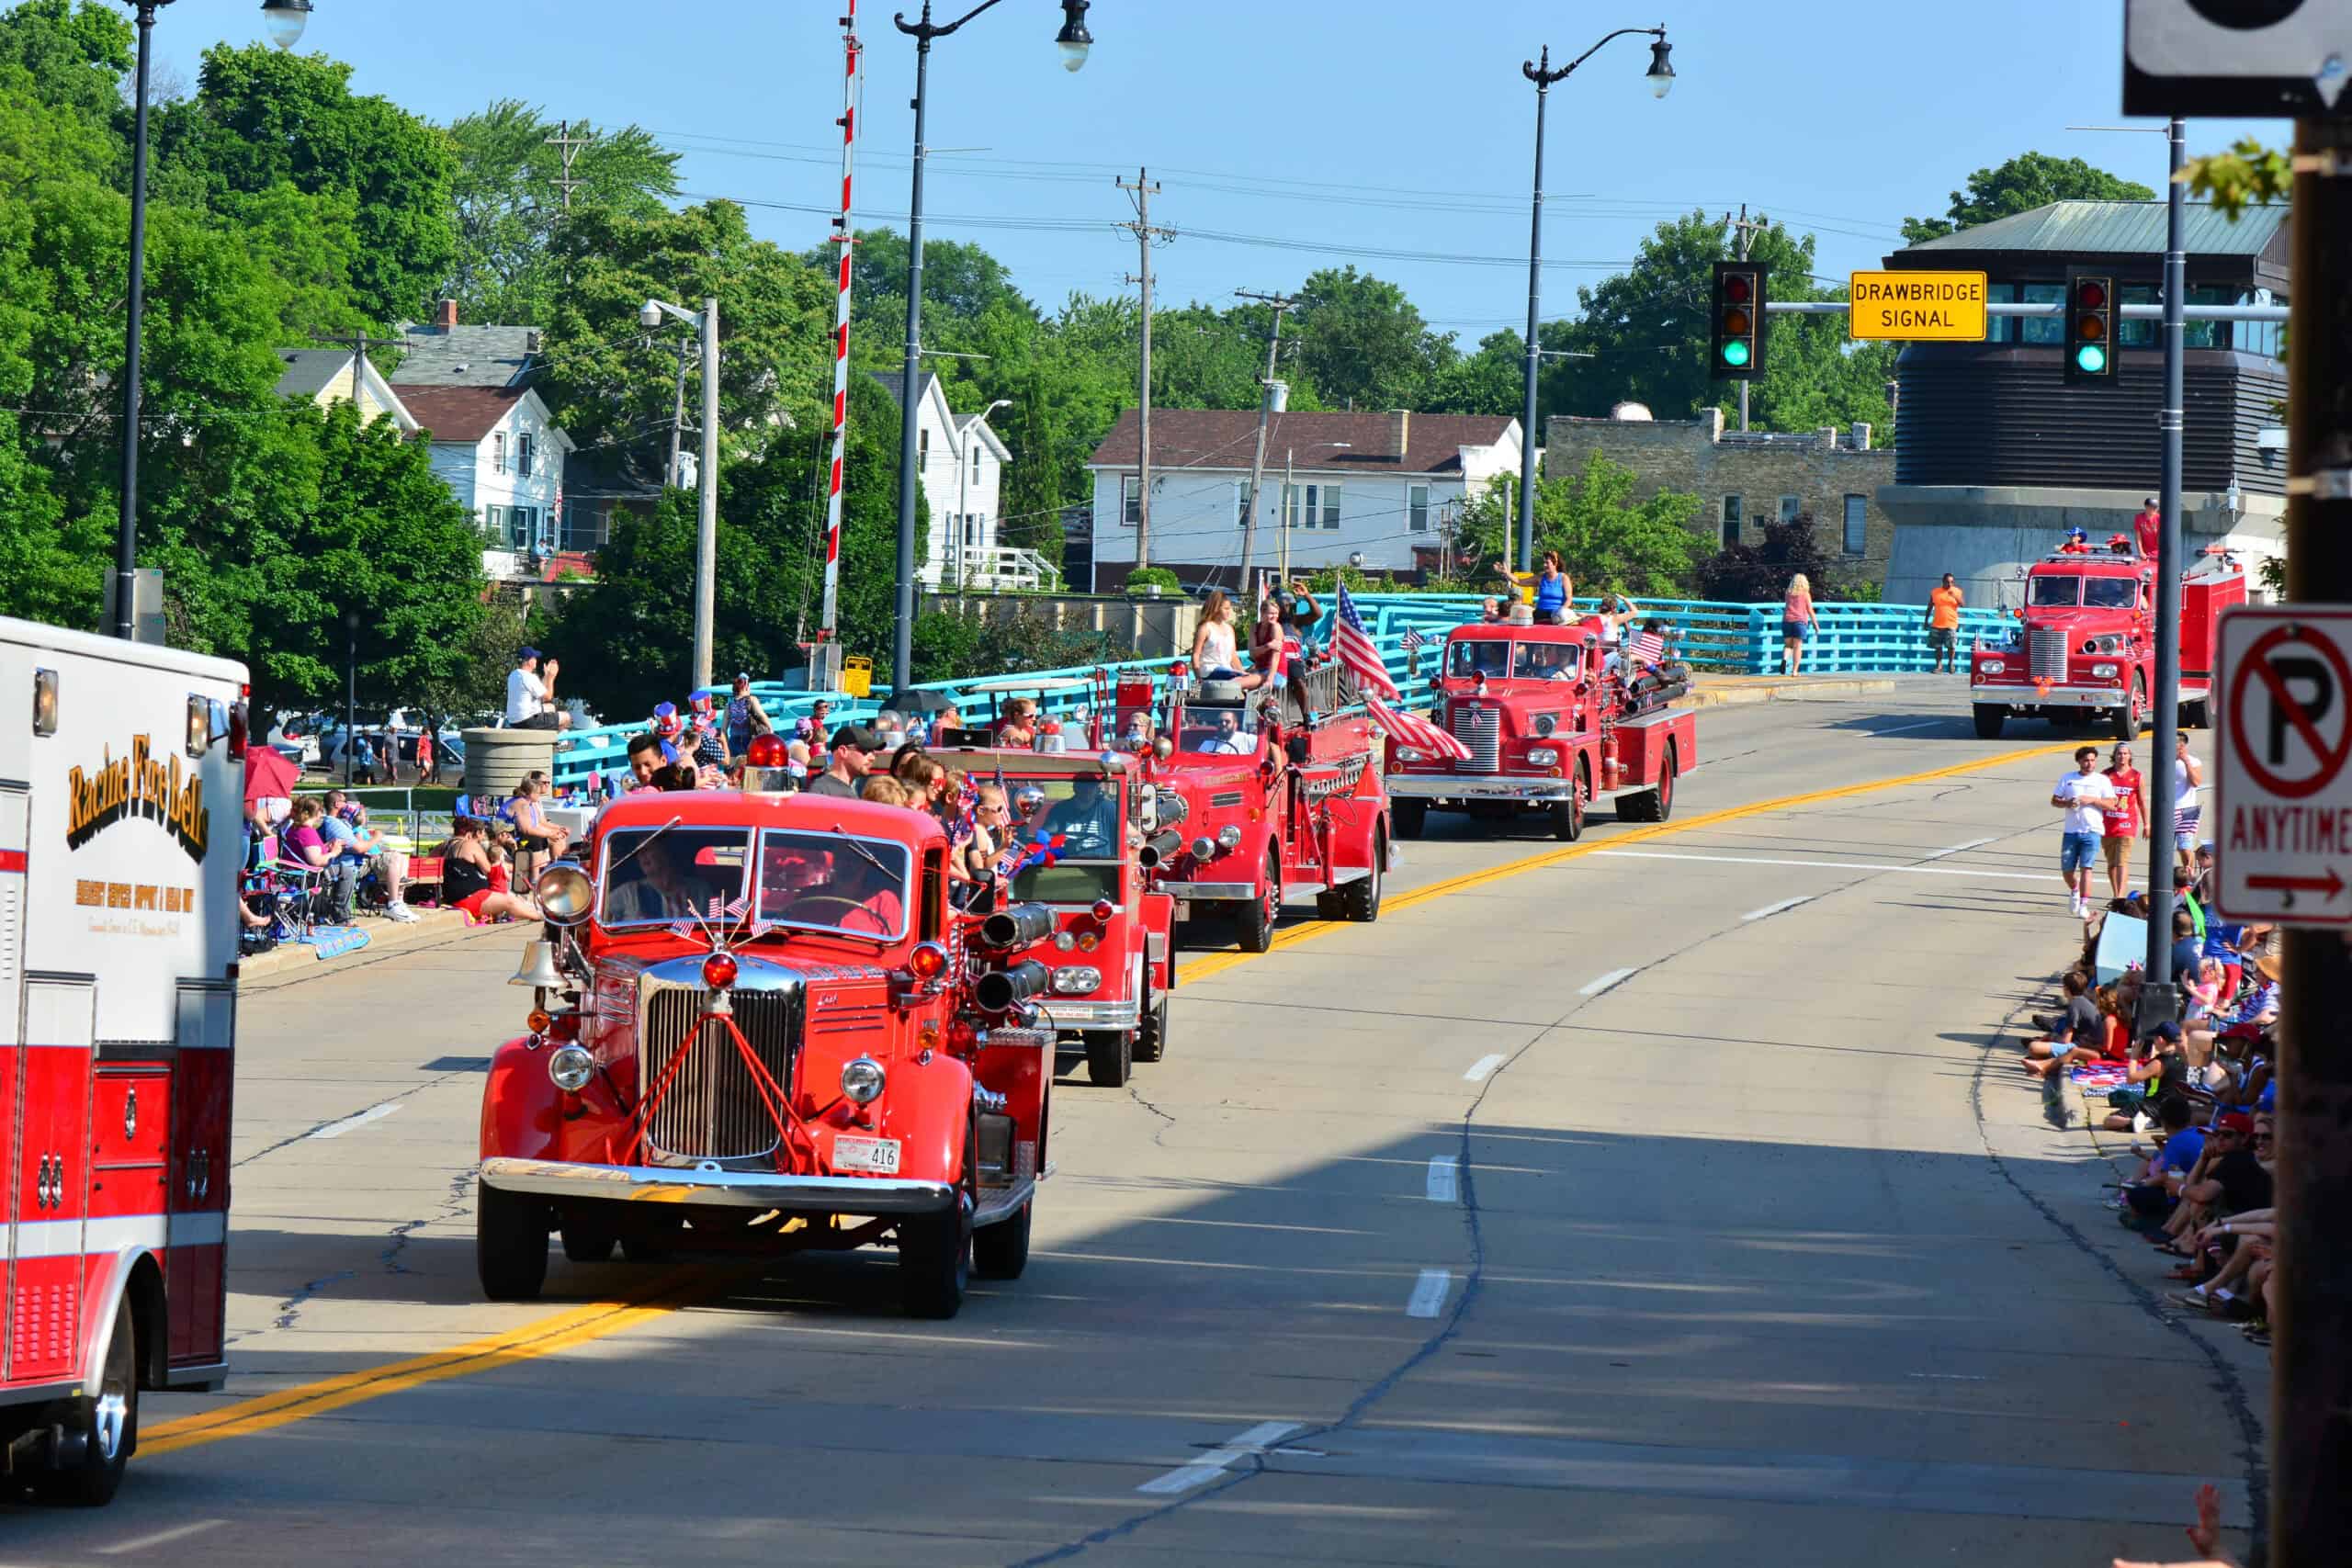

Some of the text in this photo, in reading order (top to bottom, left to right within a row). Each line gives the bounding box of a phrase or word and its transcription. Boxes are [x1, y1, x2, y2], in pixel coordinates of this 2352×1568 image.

[1855, 283, 1981, 301] DRAWBRIDGE
[1881, 310, 1955, 327] SIGNAL
[2267, 656, 2335, 765] P
[66, 741, 130, 840] Racine
[131, 732, 168, 814] Fire
[871, 1147, 895, 1166] 416
